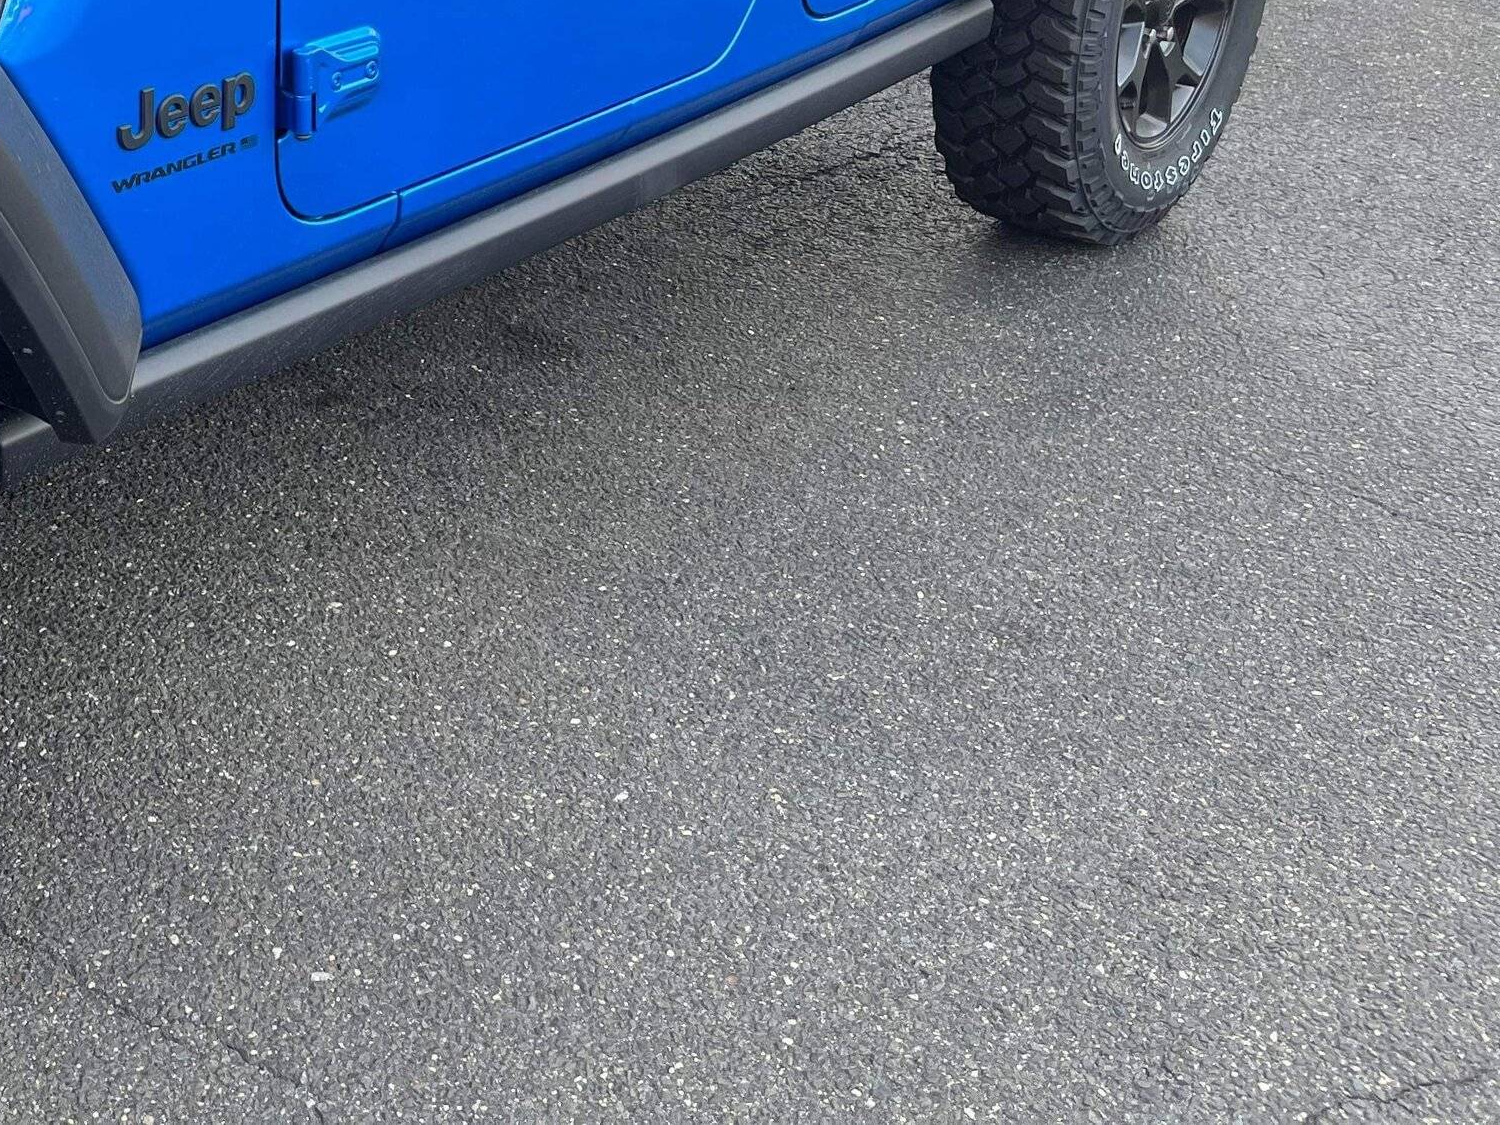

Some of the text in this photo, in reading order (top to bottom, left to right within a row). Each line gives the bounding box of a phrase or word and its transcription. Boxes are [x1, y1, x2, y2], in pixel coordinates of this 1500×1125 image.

[116, 71, 256, 151] Jeep
[1121, 107, 1223, 193] Firestone
[111, 141, 237, 194] WRANGLER
